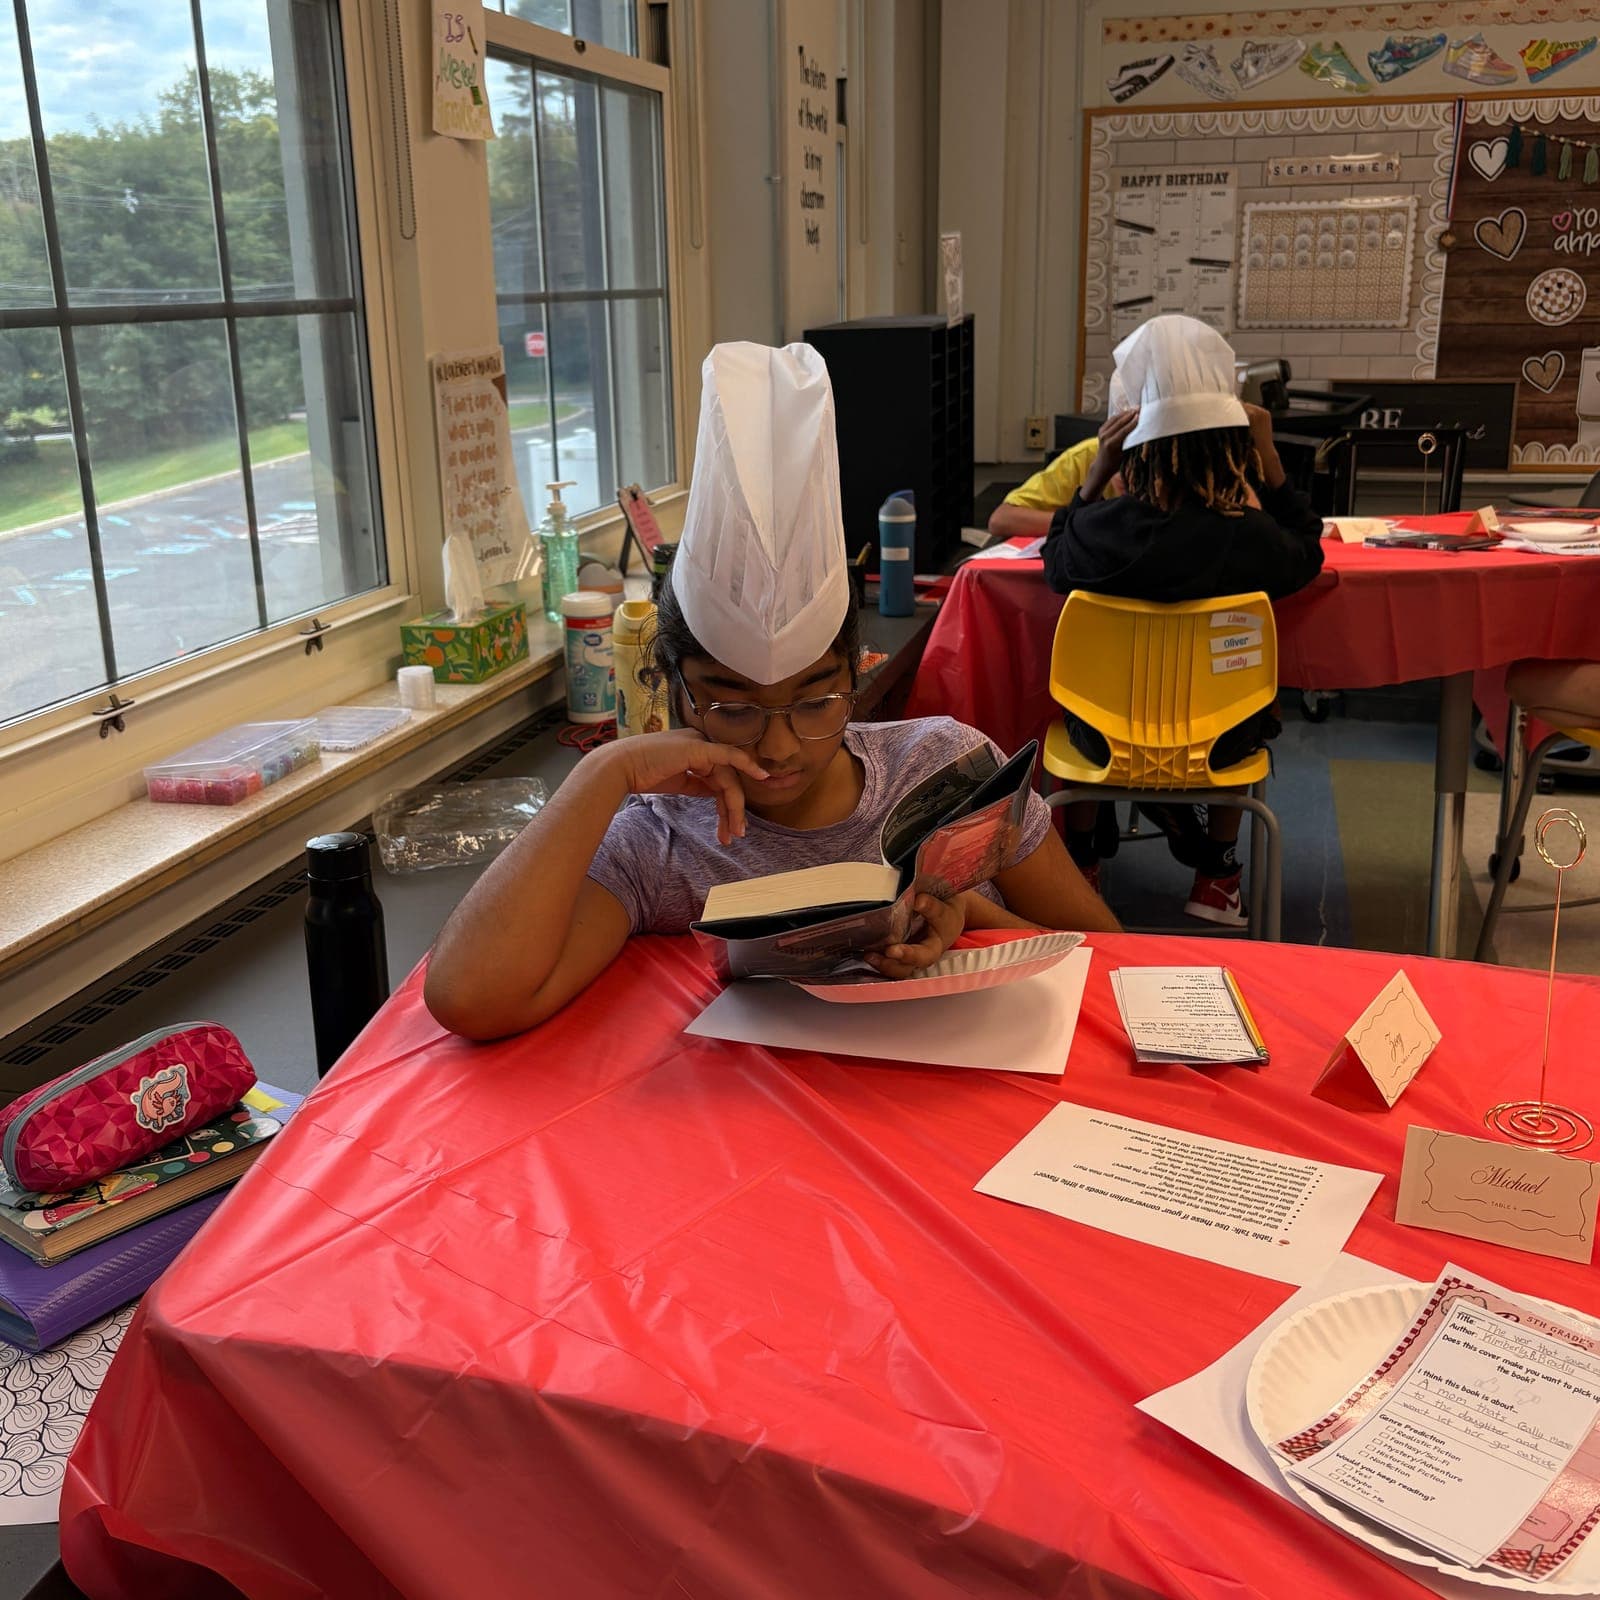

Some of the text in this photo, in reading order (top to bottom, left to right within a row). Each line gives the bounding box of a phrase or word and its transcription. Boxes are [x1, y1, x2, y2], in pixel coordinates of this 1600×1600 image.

[1273, 162, 1394, 176] SEPTEMBER
[1120, 172, 1229, 188] HAPPY BIRTHDAY
[1573, 208, 1600, 231] YO
[1224, 637, 1249, 648] Oliver
[1034, 1172, 1060, 1182] flavor!
[1060, 1179, 1078, 1188] little
[1470, 1164, 1550, 1195] Michael
[1085, 1186, 1109, 1196] needs
[1109, 1194, 1160, 1210] conversation
[1490, 1200, 1512, 1210] TABLE
[1161, 1208, 1183, 1216] your
[1191, 1216, 1213, 1226] these
[1215, 1223, 1230, 1231] Use
[1232, 1227, 1250, 1236] Talk:
[1252, 1233, 1272, 1242] Table
[1526, 1316, 1596, 1349] 5TH GRADE'S
[1442, 1334, 1461, 1345] Does
[1463, 1342, 1477, 1351] this
[1478, 1350, 1501, 1360] cover
[1502, 1359, 1523, 1370] make
[1525, 1368, 1540, 1377] you
[1541, 1374, 1561, 1385] want
[1572, 1387, 1592, 1398] pick
[1497, 1365, 1536, 1384] the book?
[1416, 1379, 1429, 1390] A
[1423, 1371, 1443, 1382] think
[1445, 1379, 1460, 1389] this
[1461, 1385, 1480, 1397] book
[1412, 1391, 1425, 1400] to
[1379, 1414, 1445, 1445] Genre Prediction
[1390, 1437, 1450, 1466] Fantasy/Sci-Fi
[1397, 1431, 1461, 1461] Realistic Fiction
[1369, 1456, 1410, 1477] Nonfiction
[1376, 1450, 1446, 1485] Historical Fiction
[1384, 1444, 1462, 1482] Mystery/Adventure
[1336, 1453, 1435, 1501] Would you keep reading?
[1347, 1473, 1372, 1489] Maybe
[1340, 1478, 1385, 1504] Not For Me
